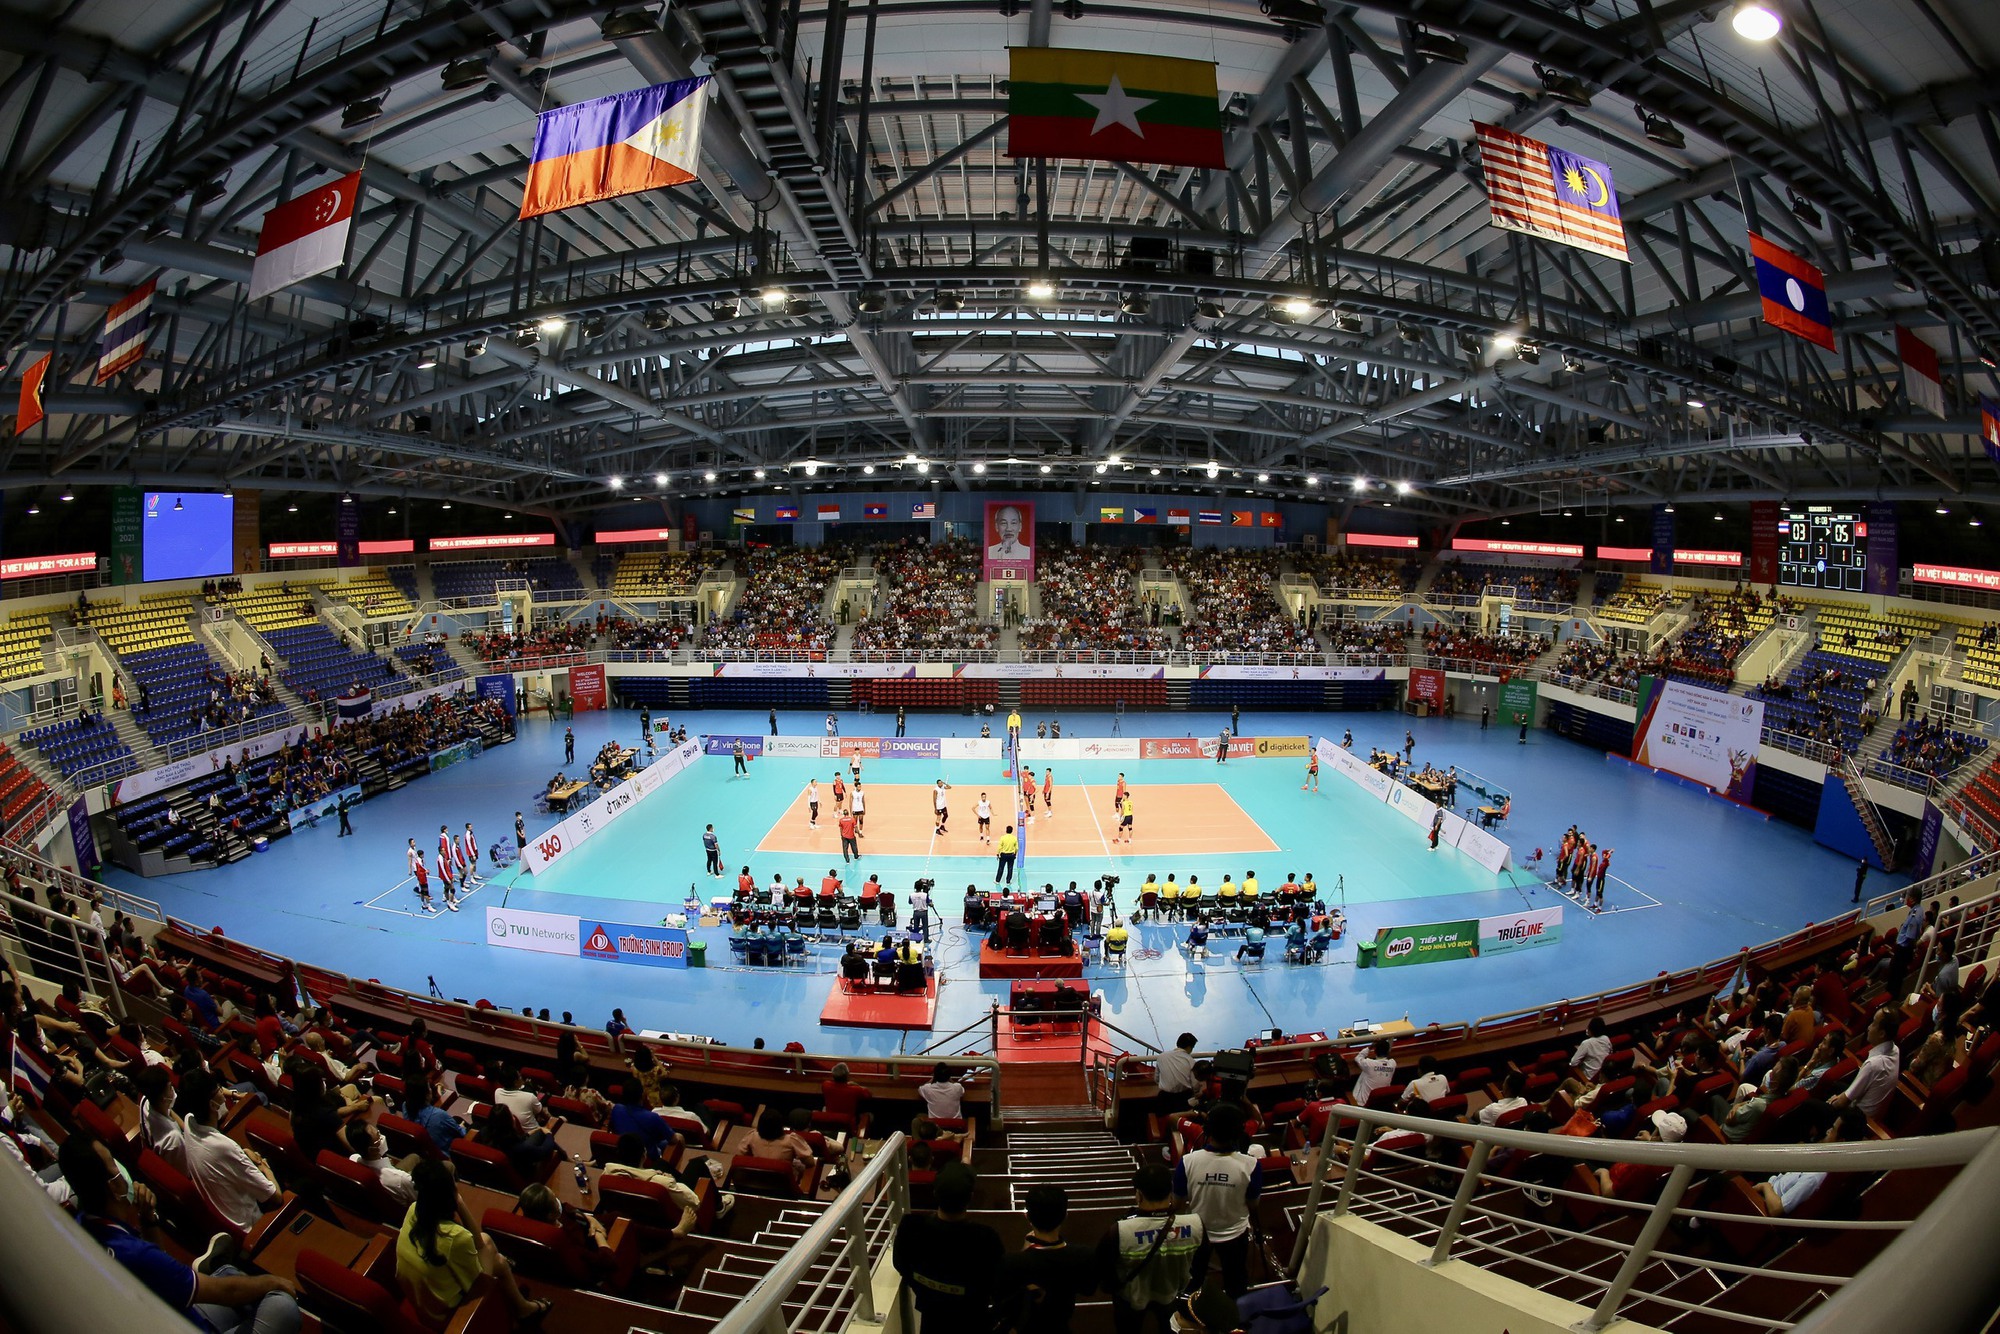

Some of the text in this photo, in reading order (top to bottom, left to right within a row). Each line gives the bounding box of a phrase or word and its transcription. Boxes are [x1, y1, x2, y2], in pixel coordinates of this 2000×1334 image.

[1793, 523, 1806, 541] 03
[1835, 524, 1849, 542] 05
[7, 564, 23, 573] VIET
[24, 562, 38, 571] NAM
[40, 561, 55, 570] 2021
[74, 558, 80, 566] A
[1918, 568, 1925, 577] 31
[1926, 569, 1941, 580] VIỆT
[1942, 570, 1957, 581] NAM
[1957, 572, 1972, 582] 2021
[216, 610, 221, 618] D
[1790, 619, 1795, 628] C
[722, 741, 761, 750] vinhone
[893, 743, 939, 751] DONGLUC
[1270, 743, 1305, 752] digiticket
[611, 792, 632, 811] TikTok
[510, 924, 576, 941] TVU Networks
[1498, 923, 1544, 941] TRUELINE
[1420, 933, 1458, 945] TIẾP Ý CHÍ
[618, 934, 684, 958] TRƯỜNG SINH GROUP
[1388, 941, 1412, 954] MILO
[1373, 1065, 1394, 1073] CAMBODIA
[1205, 1172, 1229, 1182] HB
